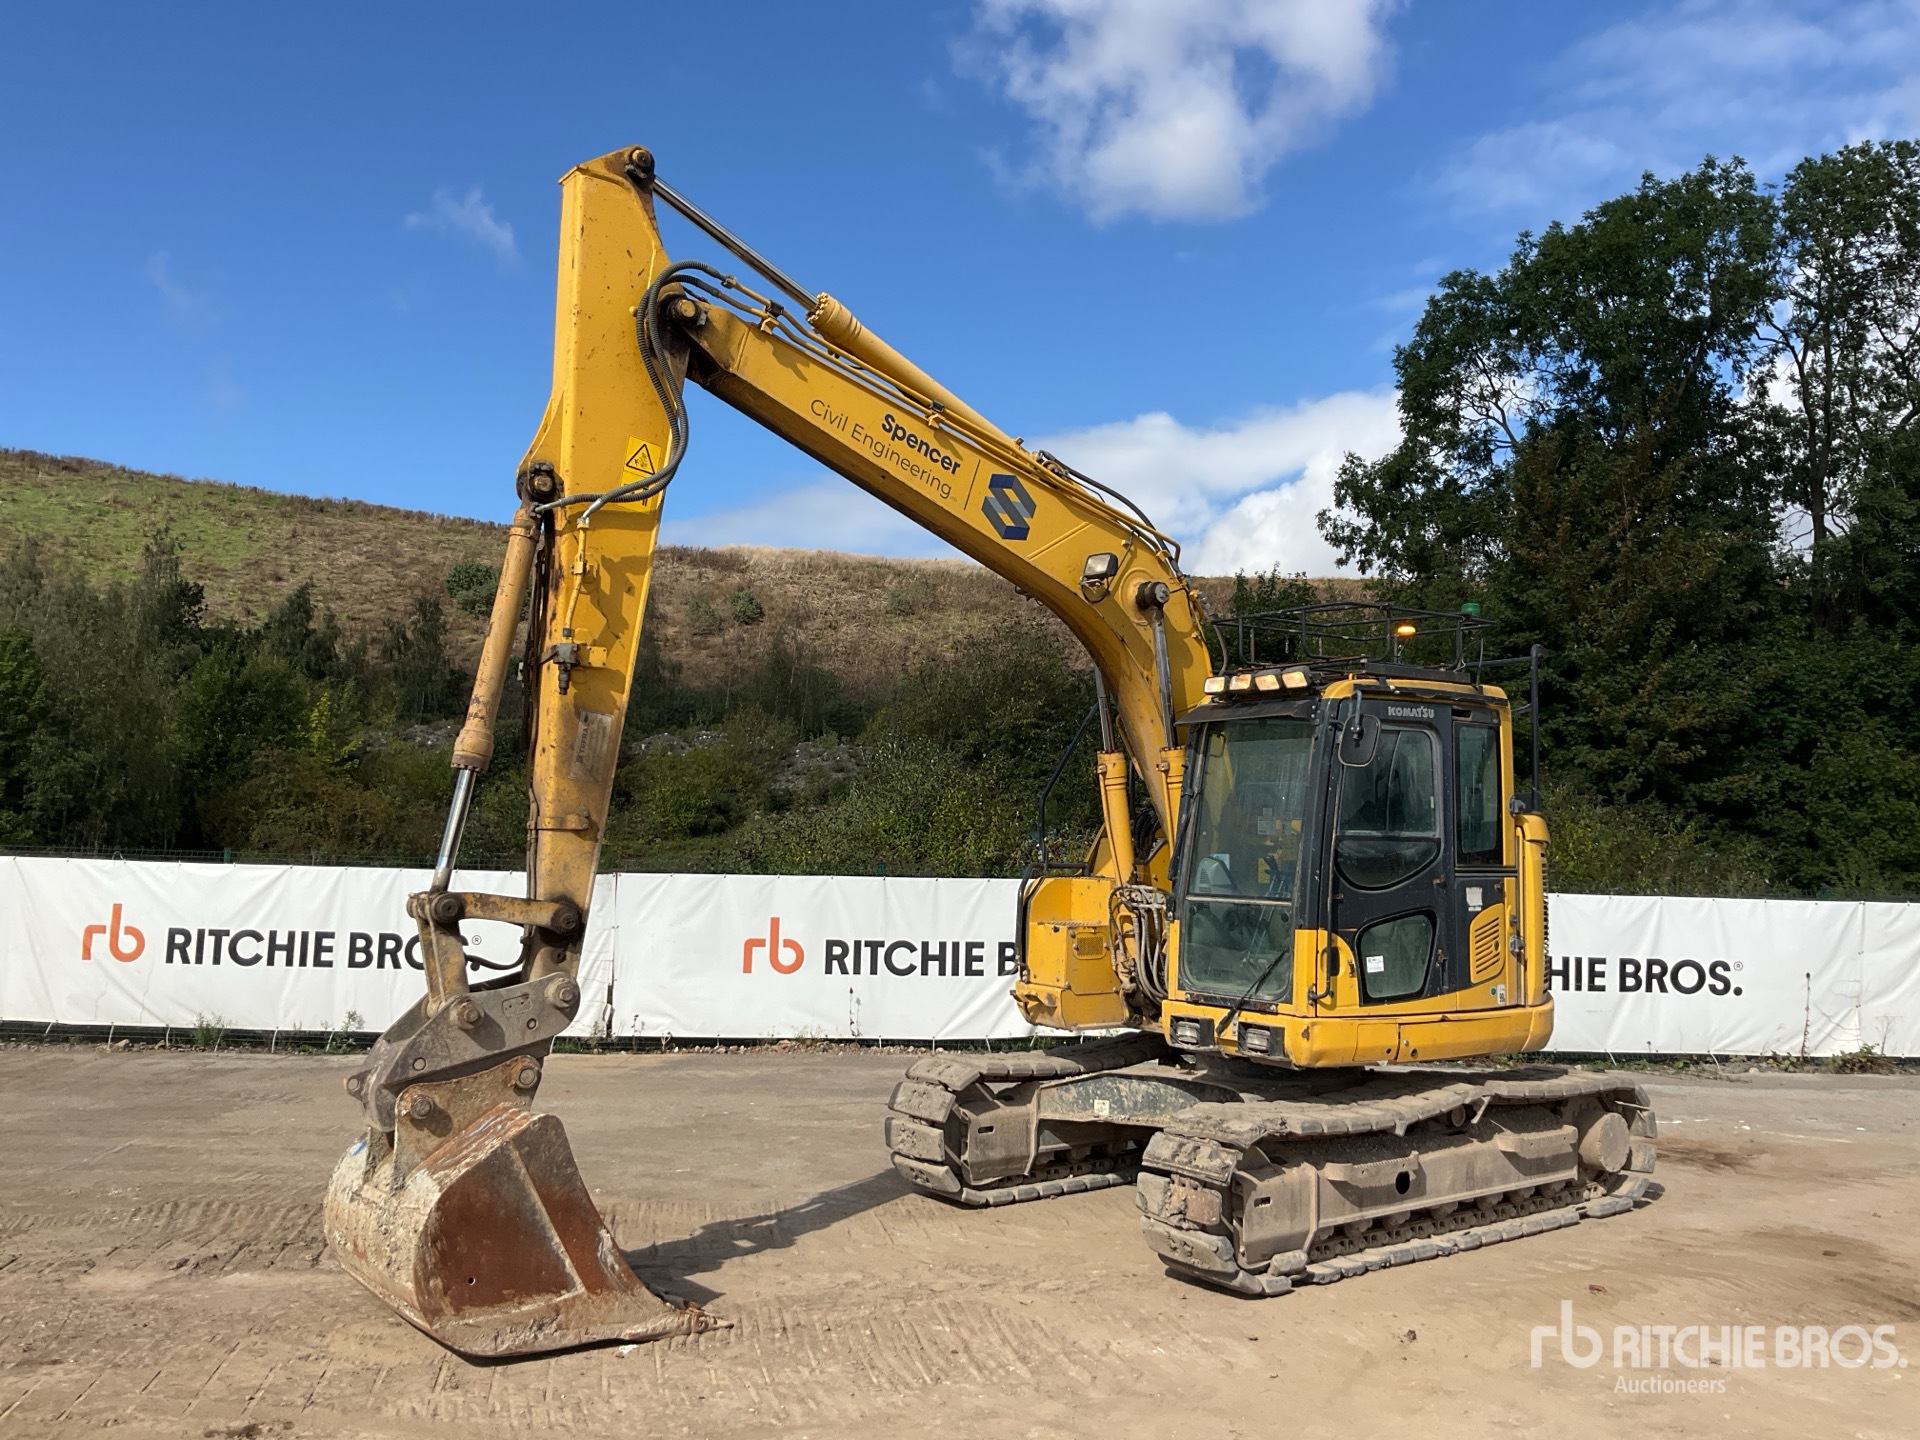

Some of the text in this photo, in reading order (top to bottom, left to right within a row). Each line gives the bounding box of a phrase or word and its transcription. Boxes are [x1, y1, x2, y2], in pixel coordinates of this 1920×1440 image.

[811, 399, 952, 499] Civil Engineering
[882, 413, 961, 475] Spencer
[1388, 705, 1435, 719] KOMATSU
[82, 902, 145, 963] rb
[166, 927, 335, 968] RITCHIE
[743, 917, 804, 974] rb
[825, 939, 985, 976] RITCHIE
